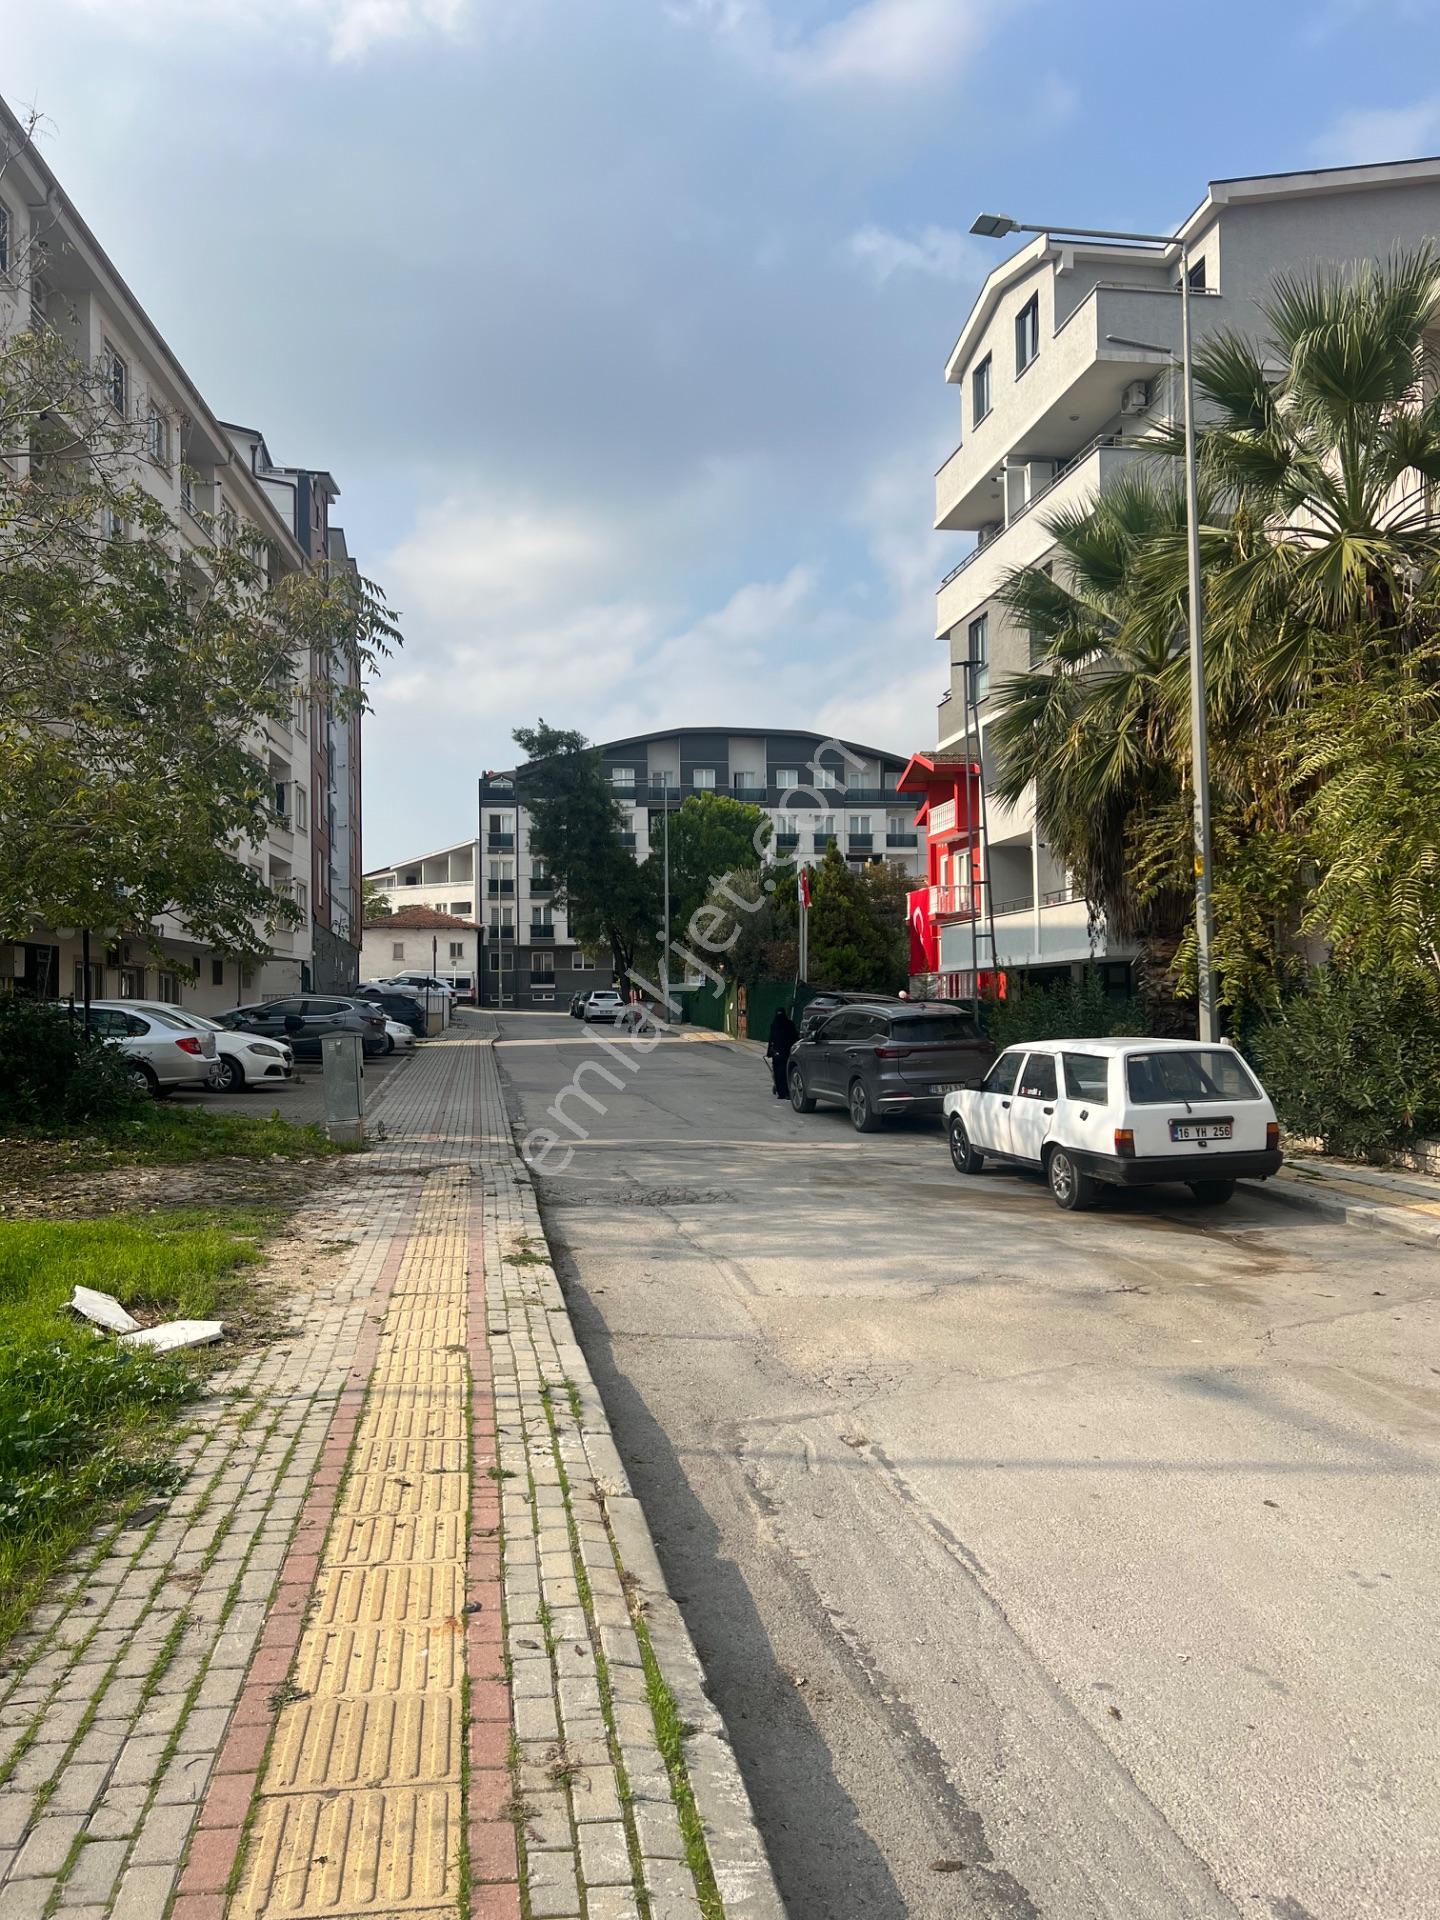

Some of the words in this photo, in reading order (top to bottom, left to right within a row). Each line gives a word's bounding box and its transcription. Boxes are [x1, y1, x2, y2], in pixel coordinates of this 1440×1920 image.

[1179, 1128, 1189, 1138] 16
[1195, 1127, 1207, 1137] YH
[1213, 1126, 1230, 1137] 256
